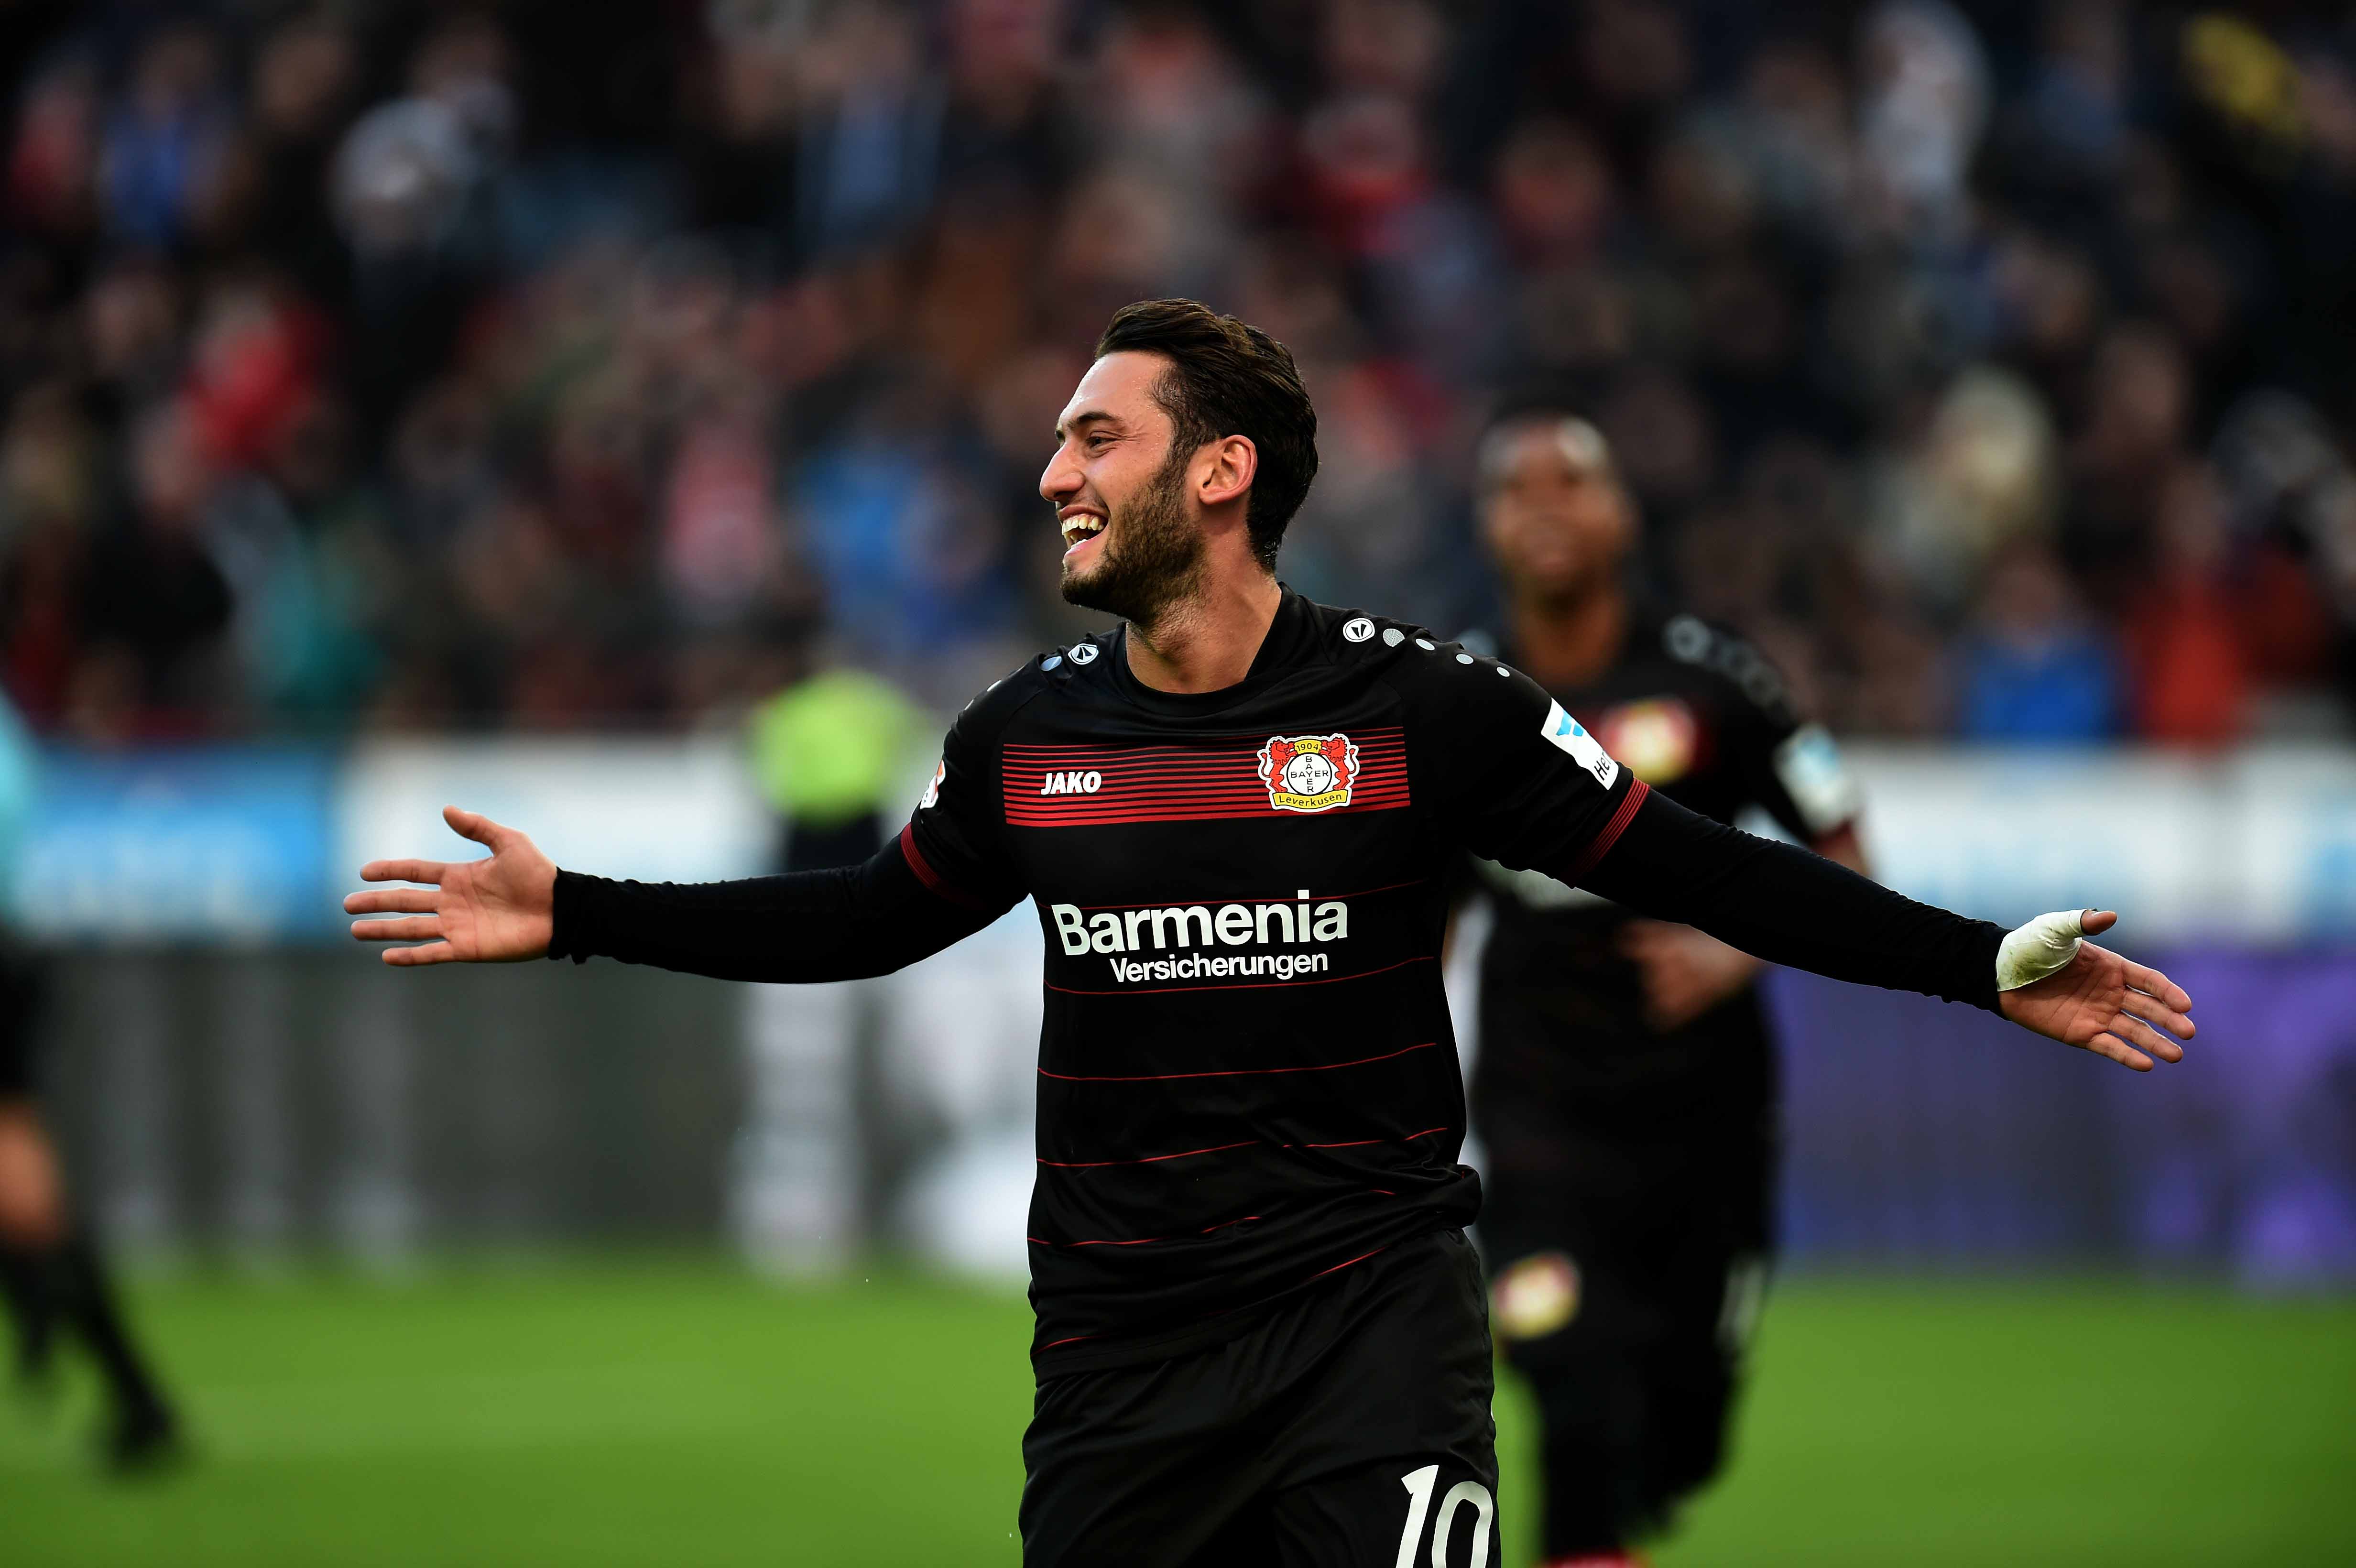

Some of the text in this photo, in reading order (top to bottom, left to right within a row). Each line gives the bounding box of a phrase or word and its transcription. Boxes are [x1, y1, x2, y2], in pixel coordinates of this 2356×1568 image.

[1296, 742, 1319, 751] 1904
[1041, 771, 1102, 795] JAKO
[1290, 770, 1329, 778] BAYER
[1305, 755, 1314, 793] BAYER
[1279, 794, 1342, 806] Leverkusen
[1051, 889, 1348, 956] Barmenia
[1110, 951, 1328, 982] Versicherungen
[1396, 1465, 1494, 1568] 10
